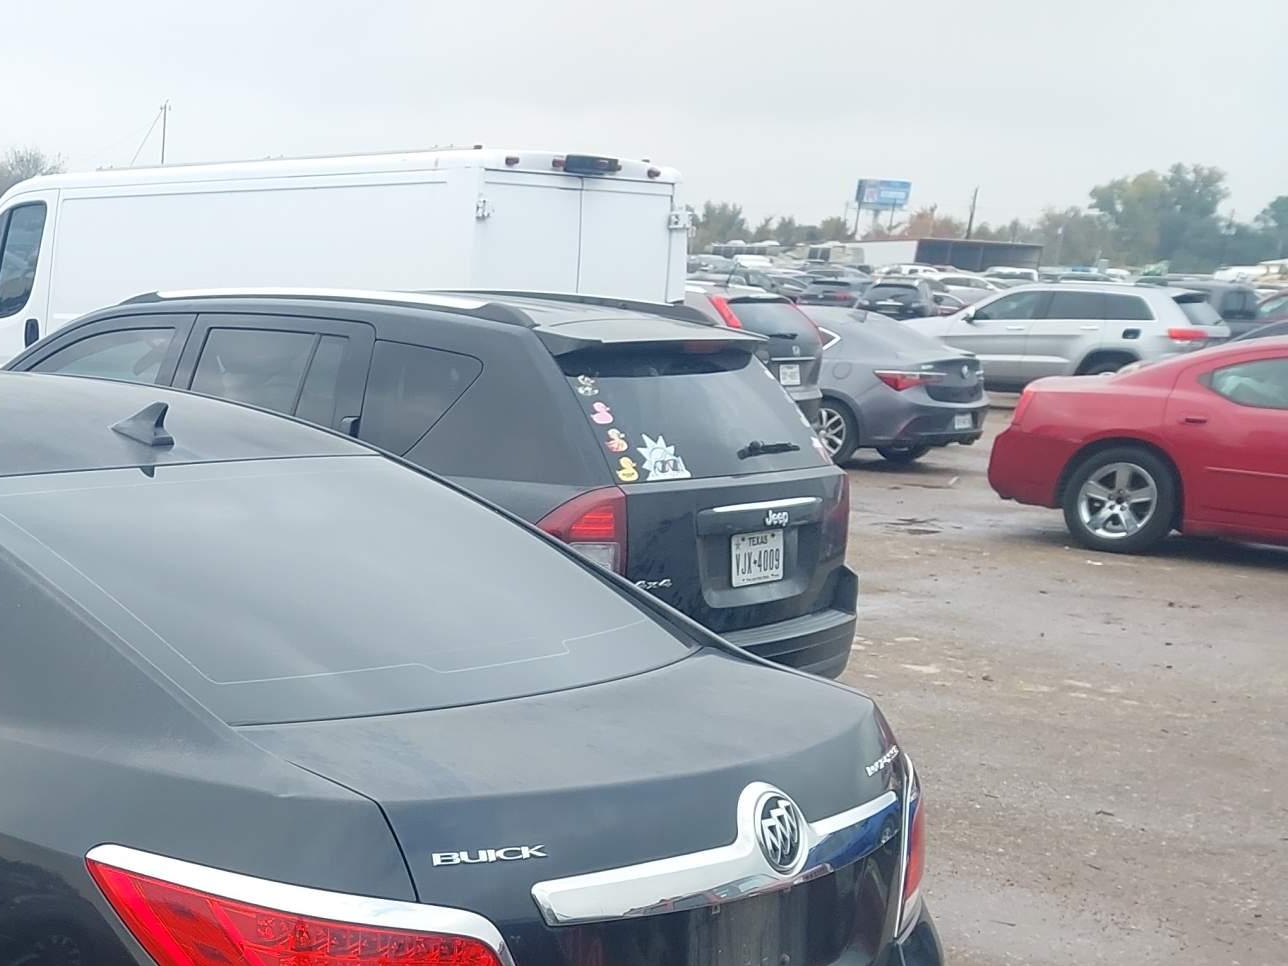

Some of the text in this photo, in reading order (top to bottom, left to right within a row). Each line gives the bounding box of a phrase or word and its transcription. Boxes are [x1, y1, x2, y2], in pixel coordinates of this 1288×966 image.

[765, 509, 789, 527] Jeep
[748, 535, 768, 547] TEXAS
[431, 844, 548, 867] BUICK
